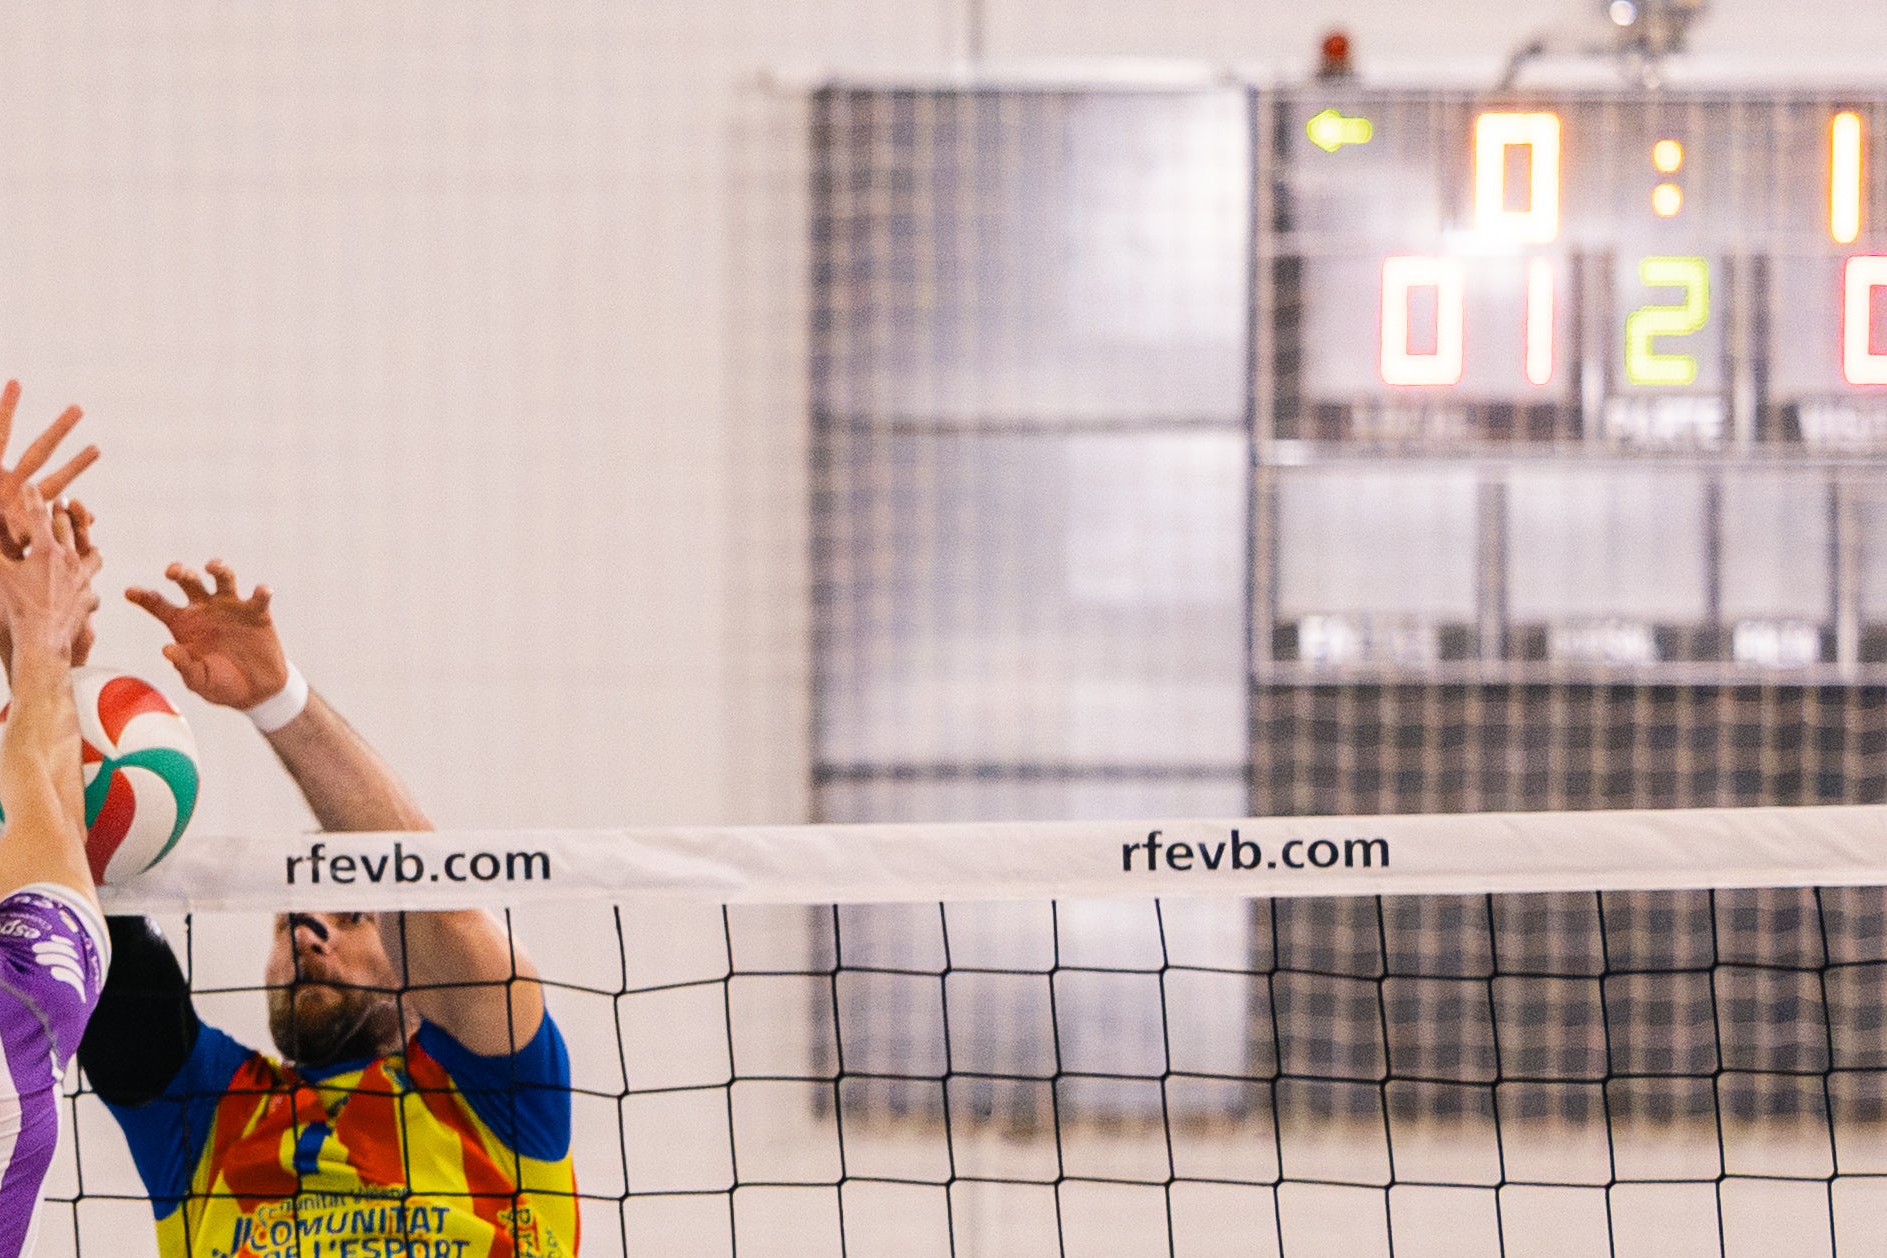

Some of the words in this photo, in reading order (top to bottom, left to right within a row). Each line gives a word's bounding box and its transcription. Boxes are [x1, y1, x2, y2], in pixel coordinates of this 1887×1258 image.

[1475, 111, 1560, 244] 0
[1831, 111, 1862, 244] 1
[1381, 255, 1554, 385] 01
[1626, 256, 1710, 386] 2
[286, 842, 551, 884] rfevb.com
[1122, 829, 1390, 871] rfevb.com
[249, 1206, 451, 1251] COMUNITAT
